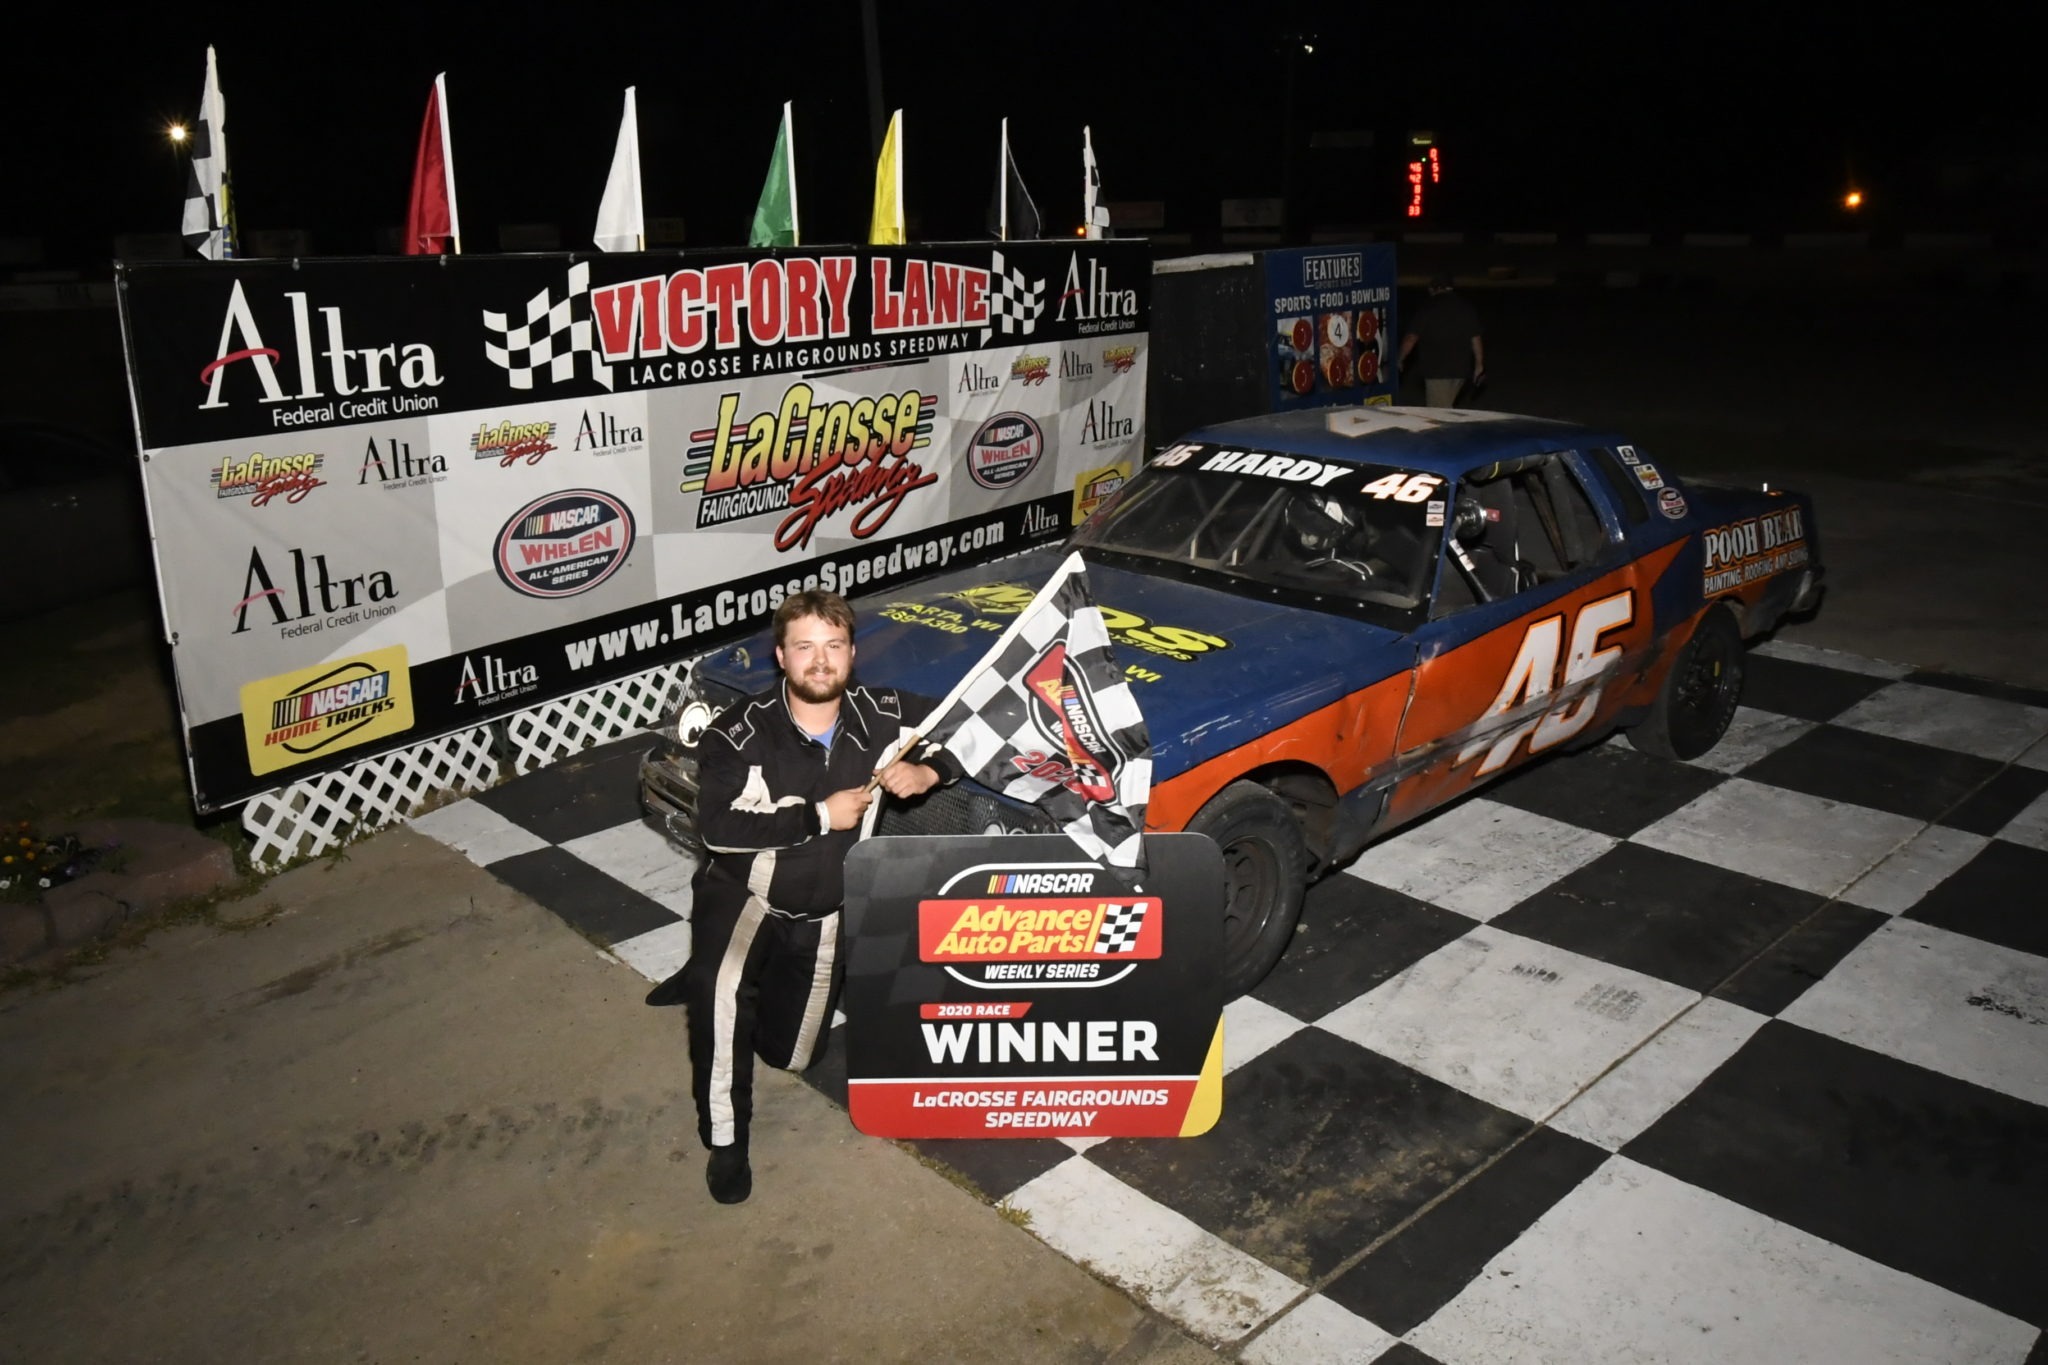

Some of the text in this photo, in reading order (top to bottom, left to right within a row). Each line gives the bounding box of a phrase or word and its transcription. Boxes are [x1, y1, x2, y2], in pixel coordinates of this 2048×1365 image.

[1055, 249, 1139, 322] Altra
[1306, 257, 1360, 281] FEATURES
[591, 256, 991, 362] VICTORY LANE
[1274, 286, 1391, 314] SPORTS FOOD BOWLING
[1078, 319, 1136, 334] Federal Credit Union
[1334, 322, 1343, 339] 4
[198, 279, 445, 409] Altra
[630, 332, 969, 385] LACROSSE FAIRGROUNDS SPEEDWAY
[958, 362, 999, 393] Altra
[1059, 350, 1093, 378] Altra
[272, 394, 439, 427] Federal Credit Union
[1080, 397, 1133, 445] Altra
[478, 420, 551, 449] LaCrosse
[574, 409, 644, 451] Altra
[702, 382, 921, 496] LaCrosse
[997, 424, 1025, 442] NASCAR
[358, 435, 449, 485] Altra
[981, 440, 1031, 465] WHELEN
[220, 452, 316, 489] LaCrosse
[383, 475, 448, 491] Federal Credit Union
[1199, 450, 1354, 487] HARDY
[1361, 473, 1443, 503] 46
[549, 504, 600, 532] NASCAR
[700, 484, 791, 525] FAIRGROUNDS
[774, 451, 938, 552] Speedway
[1020, 503, 1059, 536] Altra
[519, 525, 613, 566] WHELEN
[1704, 522, 1759, 569] POOH
[528, 555, 609, 581] ALL-AMERICAN
[551, 569, 589, 585] SERIES
[231, 545, 399, 634] Altra
[281, 604, 397, 640] Federal Credit Union
[971, 619, 1003, 632] WI
[1108, 632, 1193, 661] YSTEMS
[310, 674, 385, 717] NASCAR
[454, 655, 540, 705] Altra
[478, 684, 538, 707] Federal Credit Union
[1453, 590, 1633, 778] 46
[264, 697, 396, 747] HOME TRACKS
[1065, 704, 1107, 754] NASCAR
[1012, 873, 1095, 894] NASCAR
[951, 903, 1092, 932] Advance
[933, 929, 1087, 956] Auto Parts
[984, 963, 1100, 980] WEEKLY SERIES
[937, 1004, 1011, 1017] 2020 RACE
[920, 1020, 1160, 1064] WINNER
[913, 1089, 1169, 1108] LaCROSSE FAIRGROUNDS
[984, 1111, 1098, 1128] SPEEDWAY
